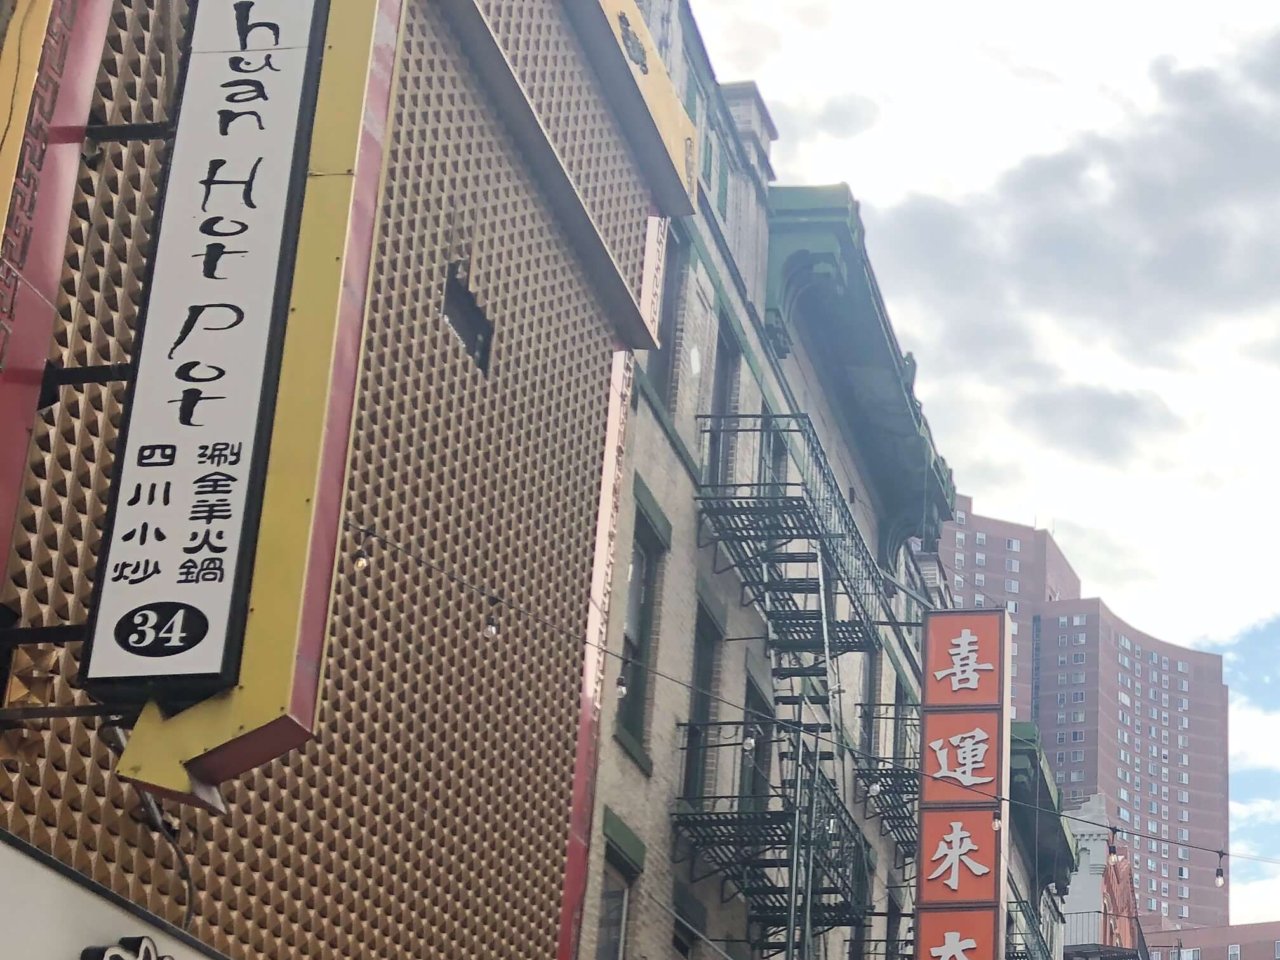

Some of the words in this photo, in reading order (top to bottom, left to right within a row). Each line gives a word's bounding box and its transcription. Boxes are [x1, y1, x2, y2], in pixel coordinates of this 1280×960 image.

[191, 157, 258, 281] Hot
[166, 303, 245, 428] Pot
[111, 444, 177, 583] 四川小炒
[176, 442, 241, 585] 涮全羊火鍋
[125, 609, 188, 649] 34
